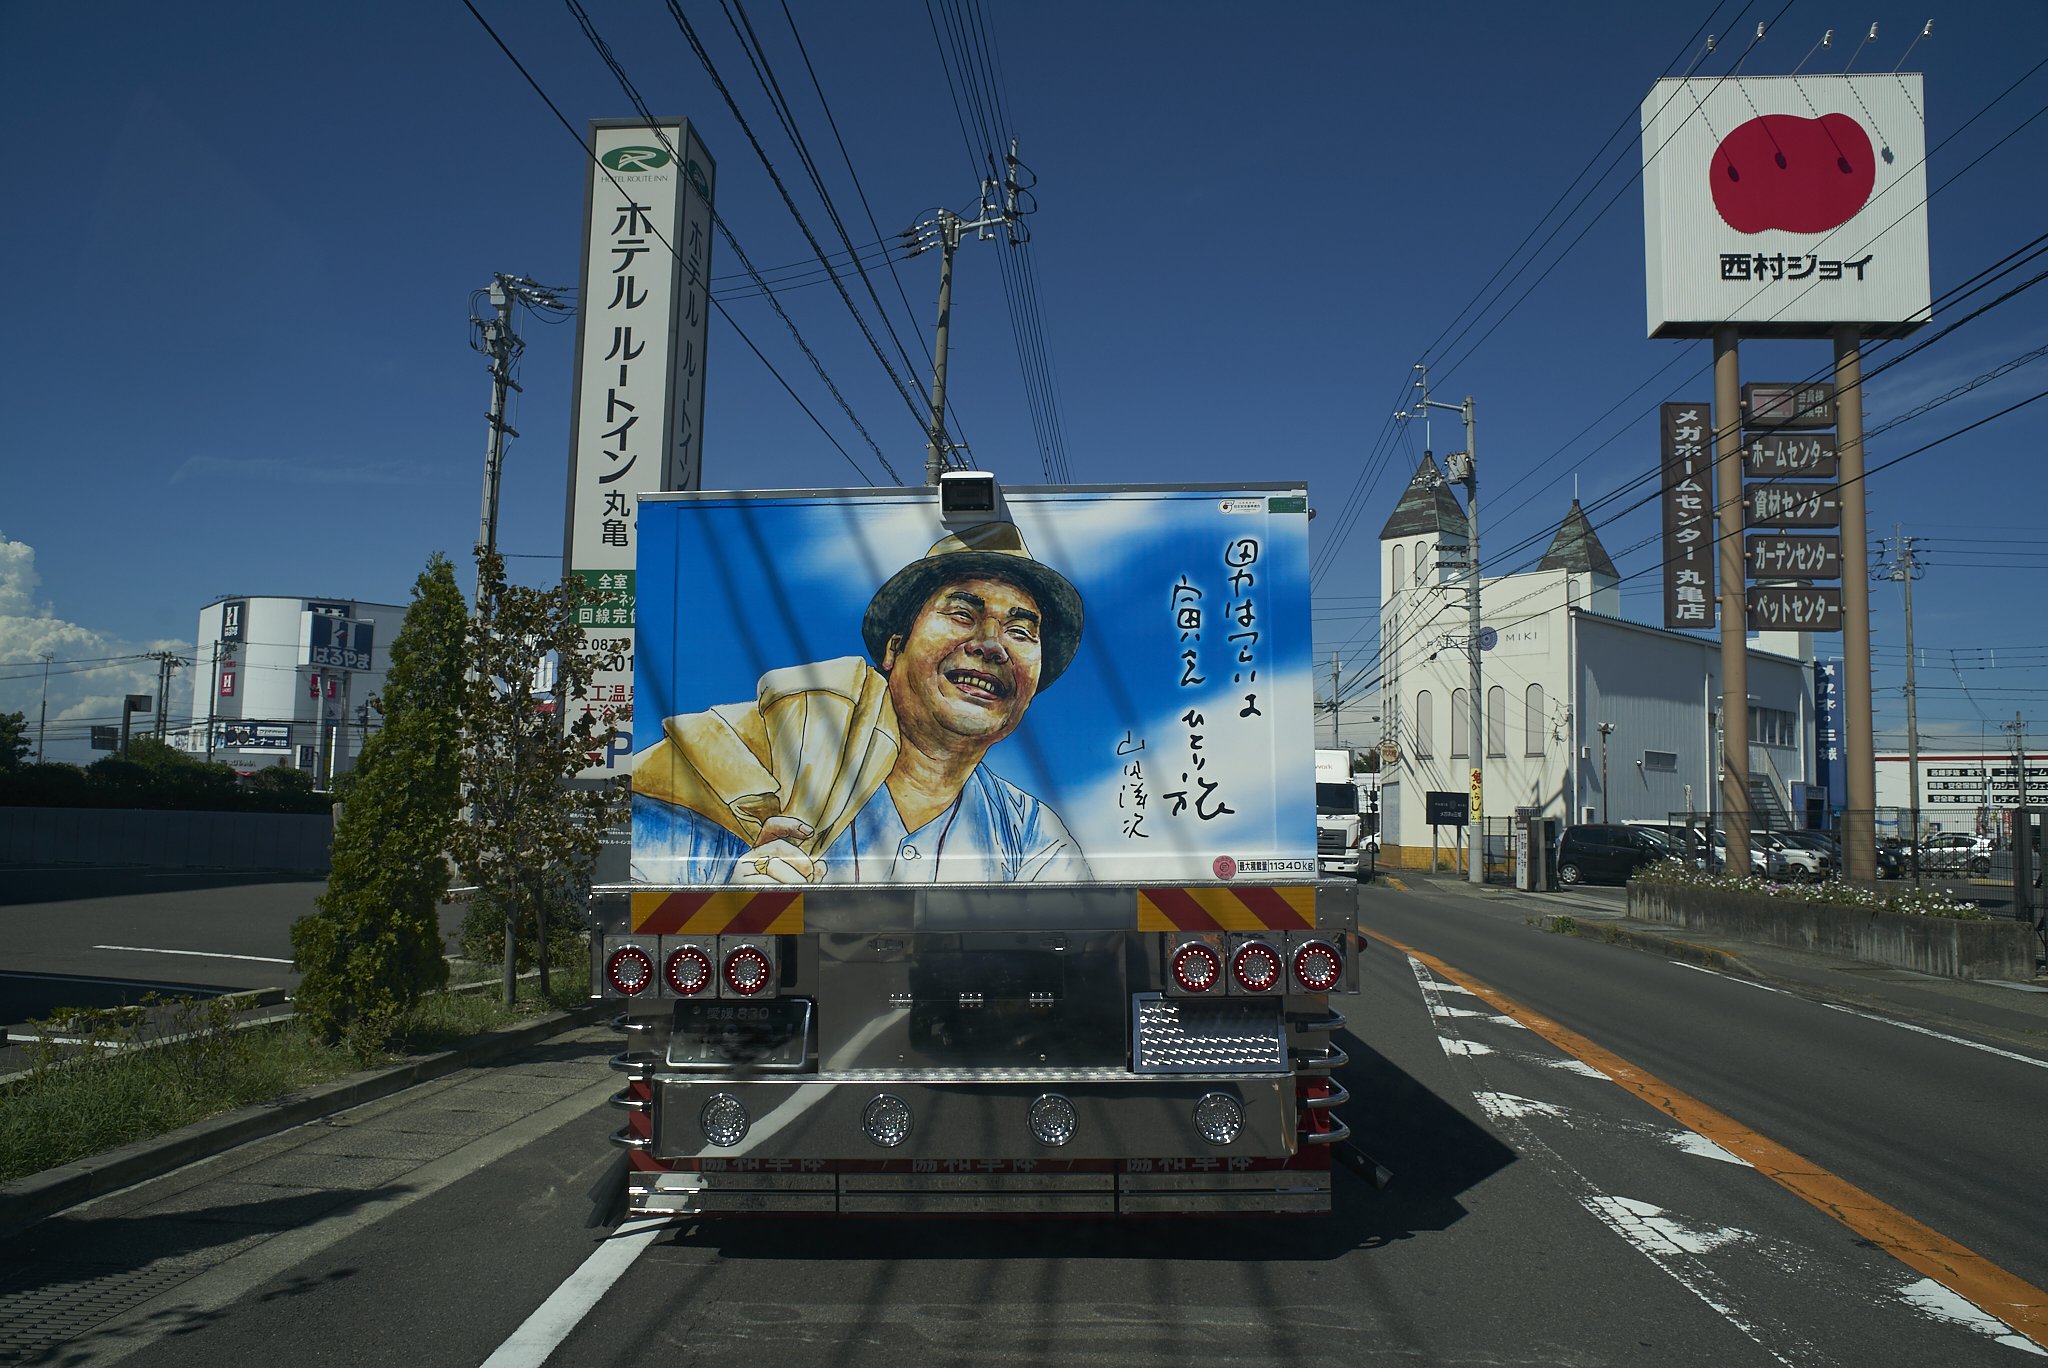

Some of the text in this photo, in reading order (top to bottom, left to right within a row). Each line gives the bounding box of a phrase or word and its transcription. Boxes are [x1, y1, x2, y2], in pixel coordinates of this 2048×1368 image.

[1720, 252, 1874, 281] 西村ジョイ
[598, 203, 652, 547] ホテル ルートイン 丸亀
[1752, 440, 1833, 468] ホームセンター
[1675, 409, 1706, 620] メガホームセンター 丸亀店
[1754, 489, 1836, 519] 資材センター
[1755, 540, 1836, 571] ガーデンセンター
[598, 573, 628, 589] 全室
[1756, 595, 1838, 623] ペットセンター
[1505, 632, 1538, 642] MIKI
[312, 646, 370, 669] はるやま
[1816, 664, 1838, 761] メガネの三城
[606, 731, 633, 769] P
